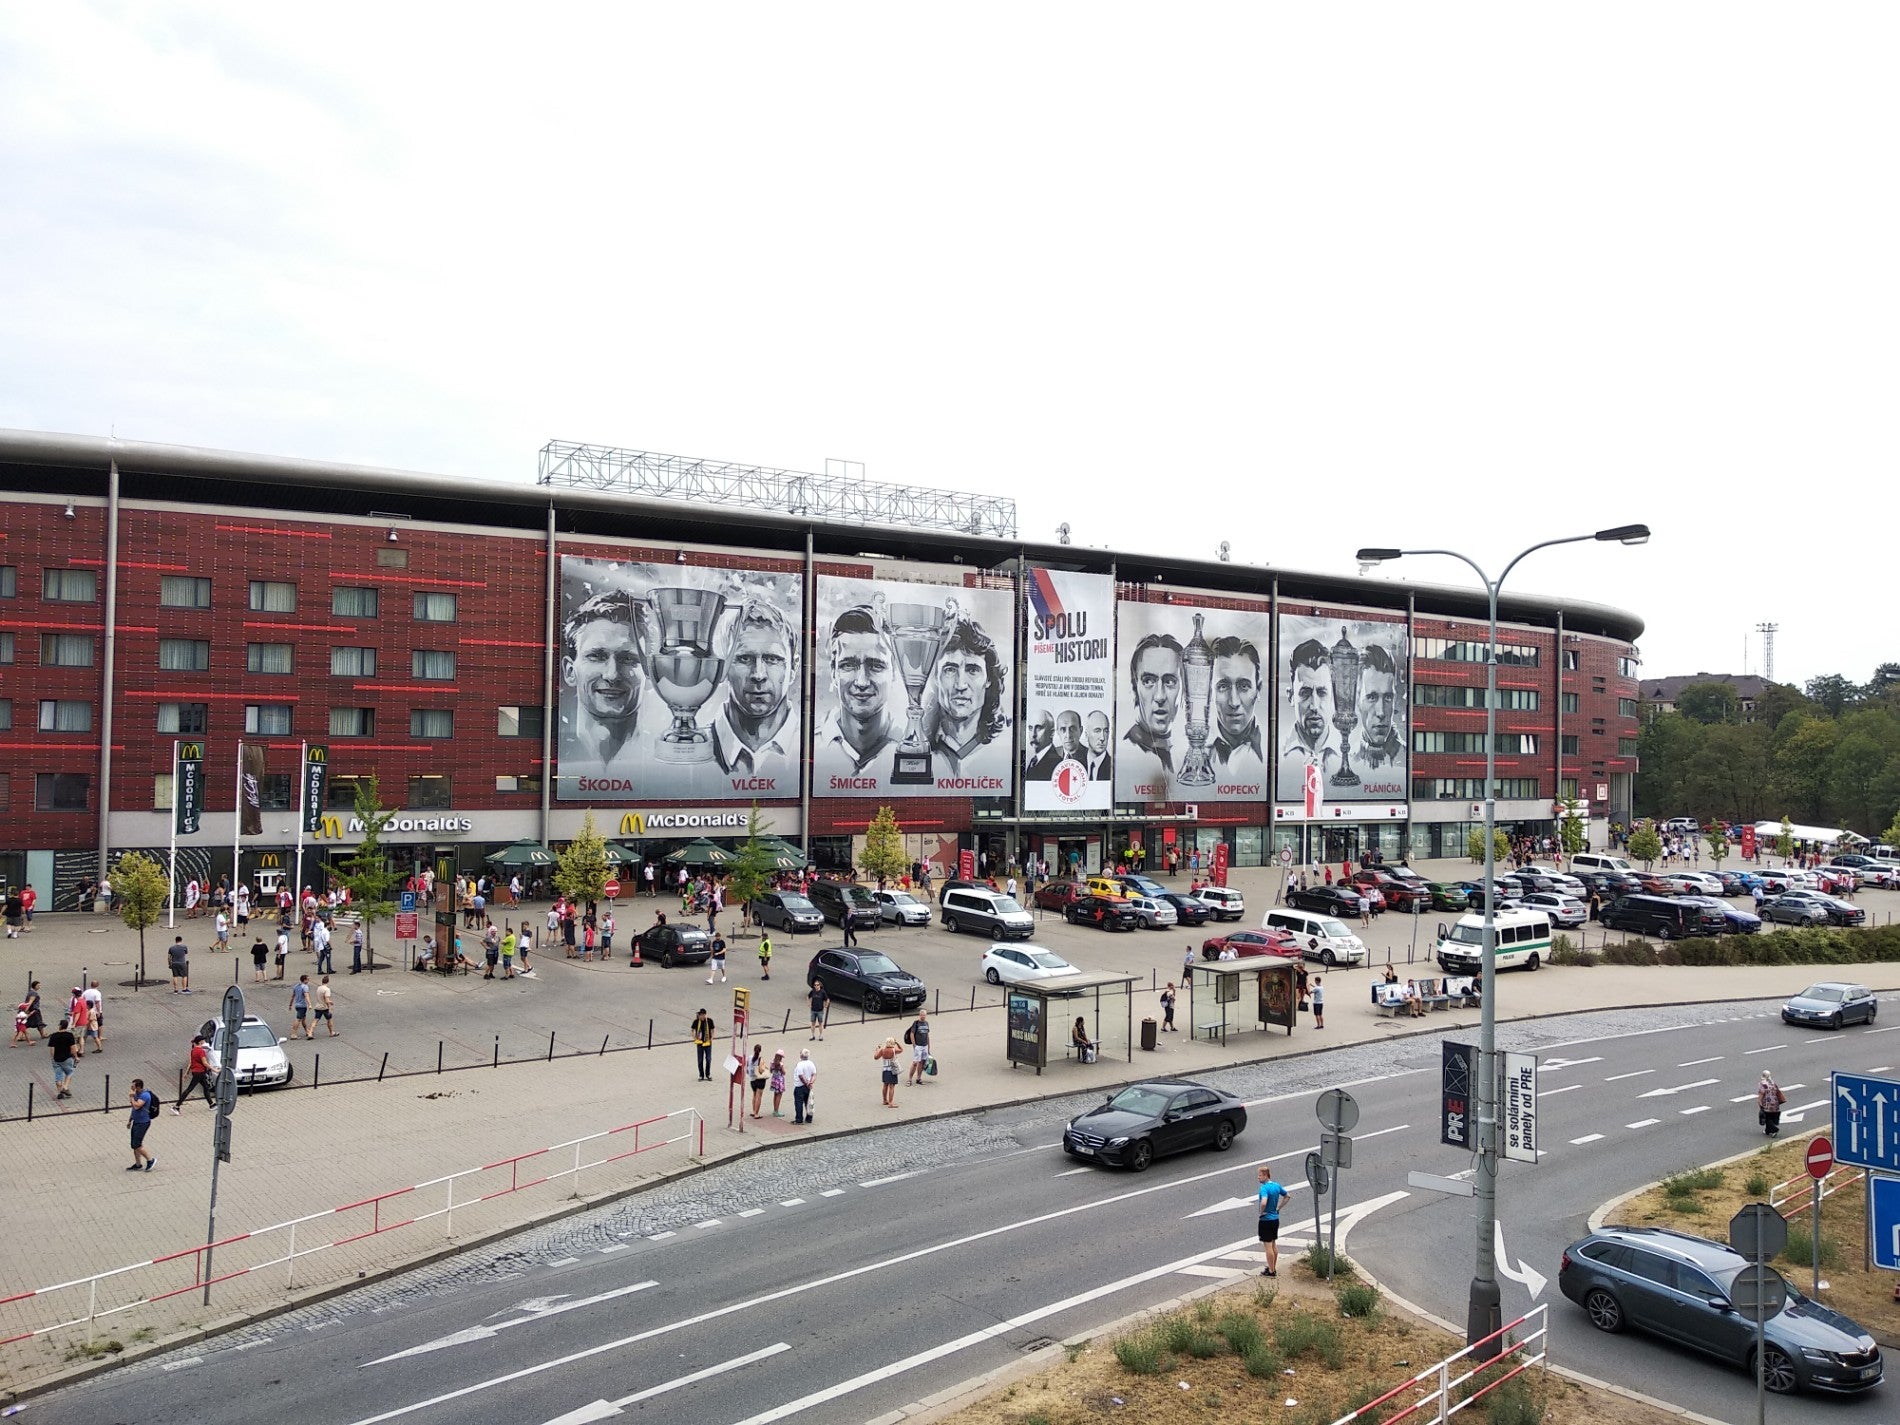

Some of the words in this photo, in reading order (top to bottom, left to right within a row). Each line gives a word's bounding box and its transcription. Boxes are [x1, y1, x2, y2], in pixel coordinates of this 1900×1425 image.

[1034, 611, 1087, 640] SPOLU
[1055, 638, 1107, 663] HISTORII
[578, 776, 633, 792] ŠKODA
[732, 776, 776, 791] VLČEK
[829, 775, 877, 790] ŠMICER
[937, 775, 1003, 790] KNOFLÍČEK
[1217, 783, 1261, 795] KOPECKÝ
[1364, 784, 1402, 794] PLÁNIČKA
[348, 816, 472, 832] MDonald's
[647, 813, 748, 828] McDonald's
[404, 894, 413, 906] P
[1521, 1066, 1532, 1090] PRE
[1507, 1077, 1519, 1131] solárními
[1521, 1094, 1532, 1111] od
[1447, 1099, 1464, 1142] PRE
[1521, 1112, 1534, 1151] panely
[1510, 1132, 1519, 1148] se
